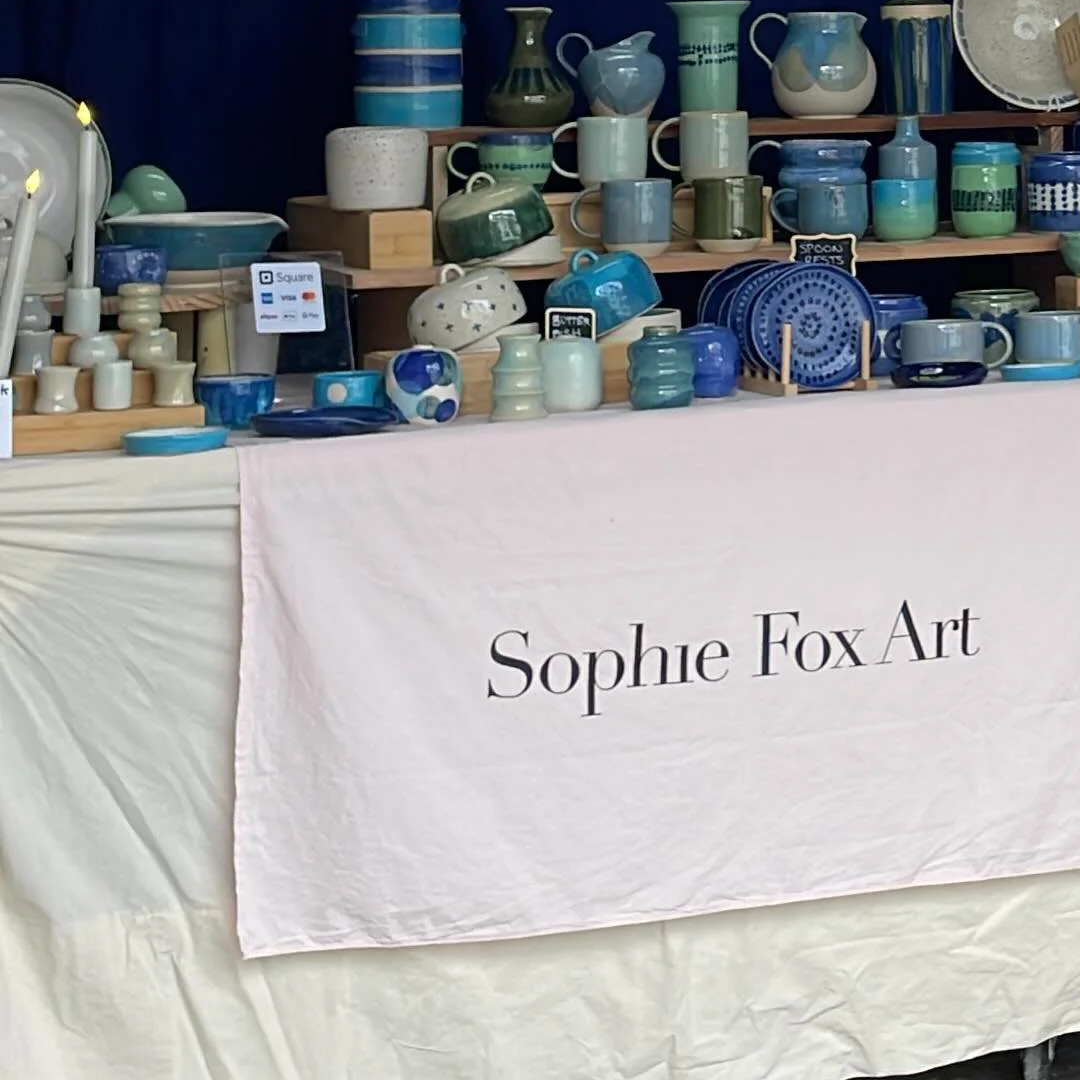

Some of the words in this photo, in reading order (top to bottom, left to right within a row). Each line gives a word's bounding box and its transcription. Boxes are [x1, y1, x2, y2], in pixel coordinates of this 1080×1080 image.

[800, 243, 844, 254] SPOON
[276, 272, 314, 283] Square
[487, 623, 729, 718] Sophie
[752, 611, 868, 677] Fox
[876, 599, 982, 664] Art
